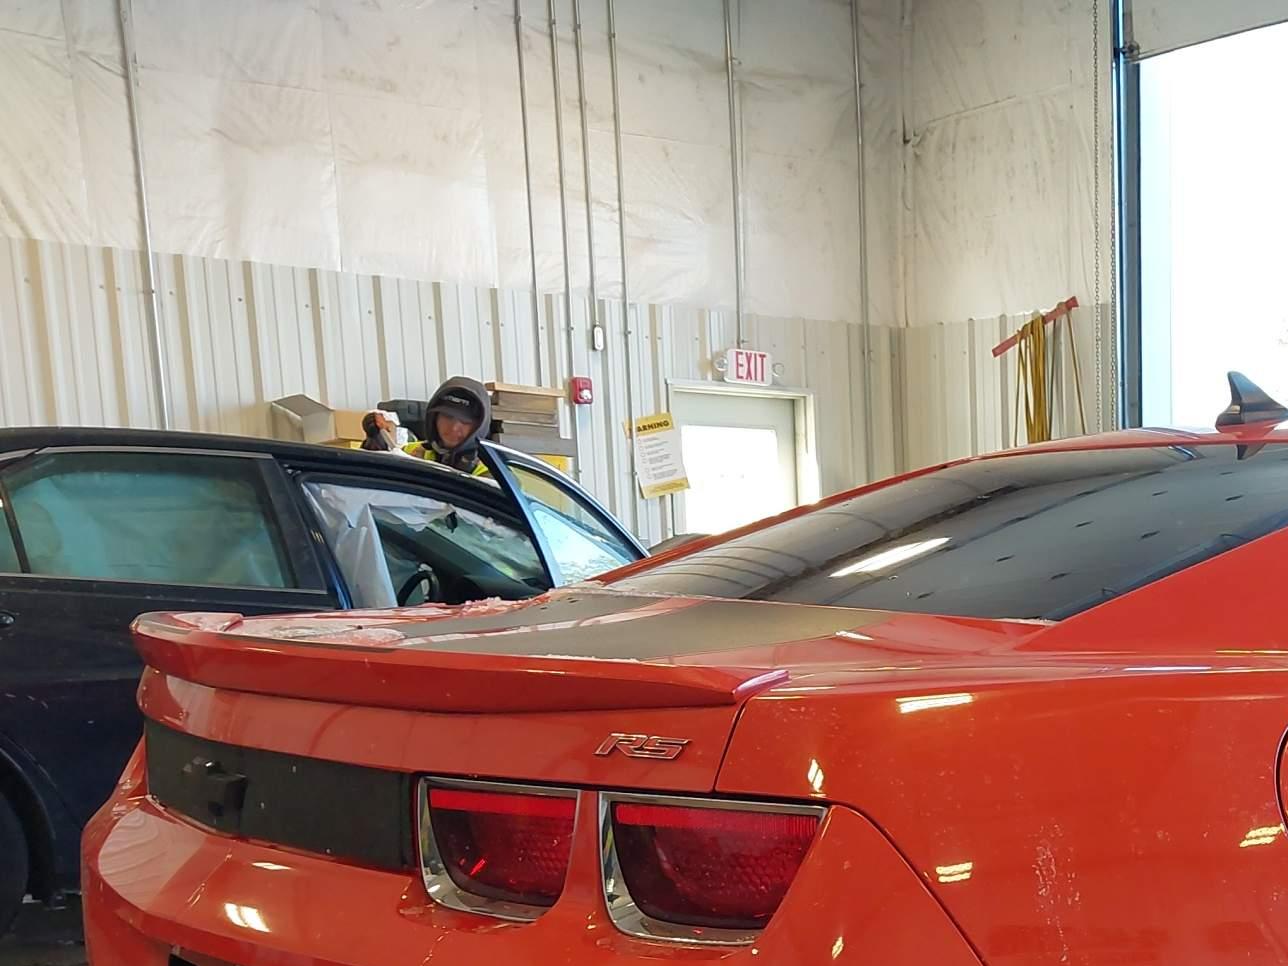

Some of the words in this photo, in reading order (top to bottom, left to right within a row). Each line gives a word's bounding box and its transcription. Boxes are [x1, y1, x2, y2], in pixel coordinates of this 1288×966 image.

[735, 351, 766, 382] EXIT
[636, 420, 670, 433] ARNING
[593, 732, 692, 760] RS
